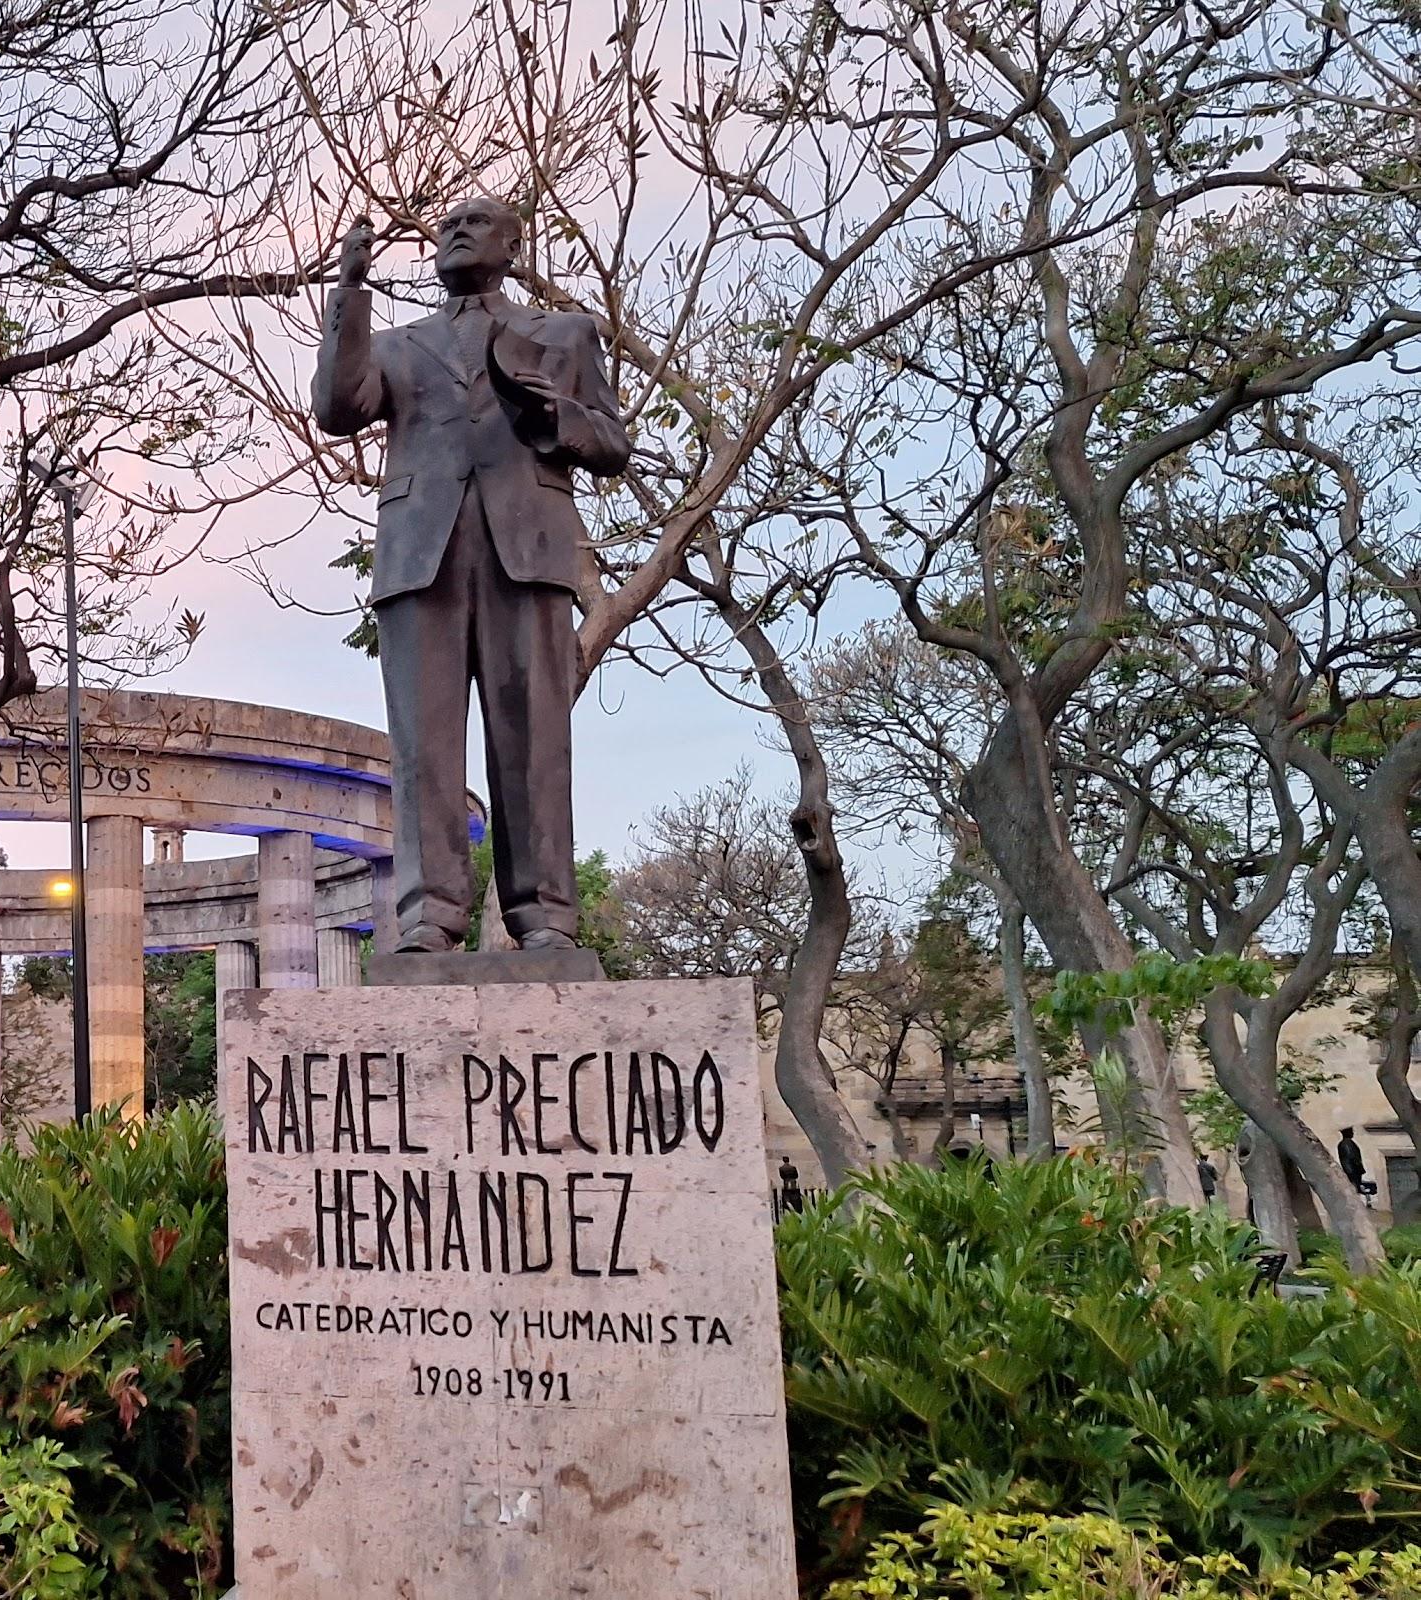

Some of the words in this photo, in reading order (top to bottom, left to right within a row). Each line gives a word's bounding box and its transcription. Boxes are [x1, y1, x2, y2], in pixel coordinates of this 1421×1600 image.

[247, 1050, 428, 1155] RAFAEL
[462, 1048, 724, 1156] PRECIADO
[489, 1308, 511, 1339] Y
[523, 1310, 733, 1346] HUMANISTA
